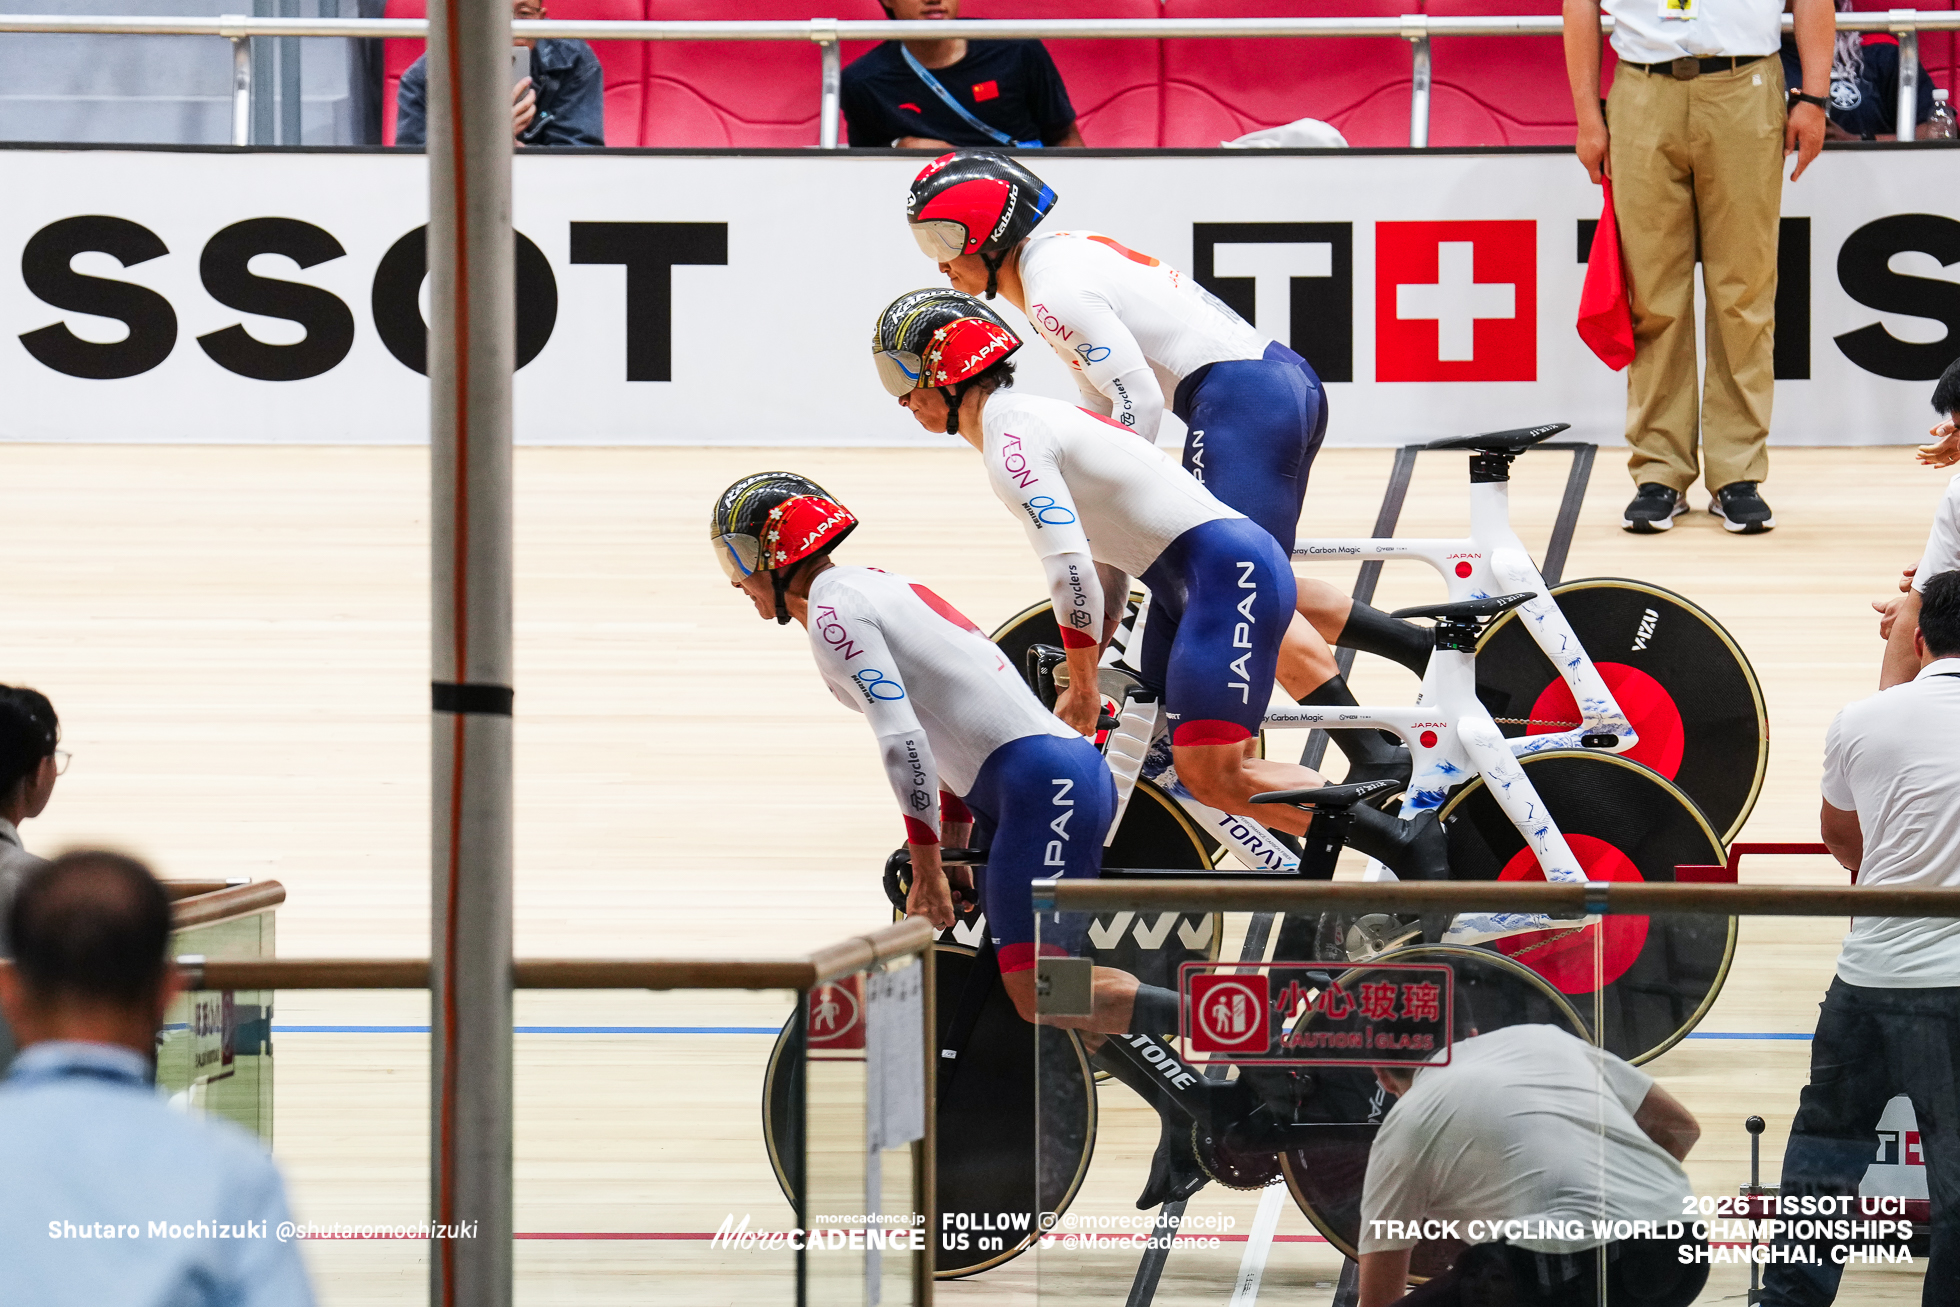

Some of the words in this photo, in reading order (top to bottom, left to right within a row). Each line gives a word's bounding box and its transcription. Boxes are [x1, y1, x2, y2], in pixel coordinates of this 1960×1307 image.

[990, 184, 1019, 242] Kabuto
[18, 214, 729, 382] SSOT
[1577, 213, 1960, 381] IS
[961, 332, 1009, 373] JAPAN
[800, 510, 846, 550] JAPAN
[1022, 502, 1043, 529] KEIRIN
[1309, 546, 1336, 554] Carbon
[1338, 546, 1360, 555] Magic
[1069, 564, 1087, 607] Cyclers
[1228, 561, 1257, 705] JAPAN
[851, 674, 875, 705] KEIRIN
[1300, 714, 1323, 722] Magic
[906, 740, 926, 786] Cyclers
[1044, 778, 1074, 924] PAN
[1275, 980, 1441, 1021] 小心玻璃
[1120, 1034, 1197, 1090] TONE
